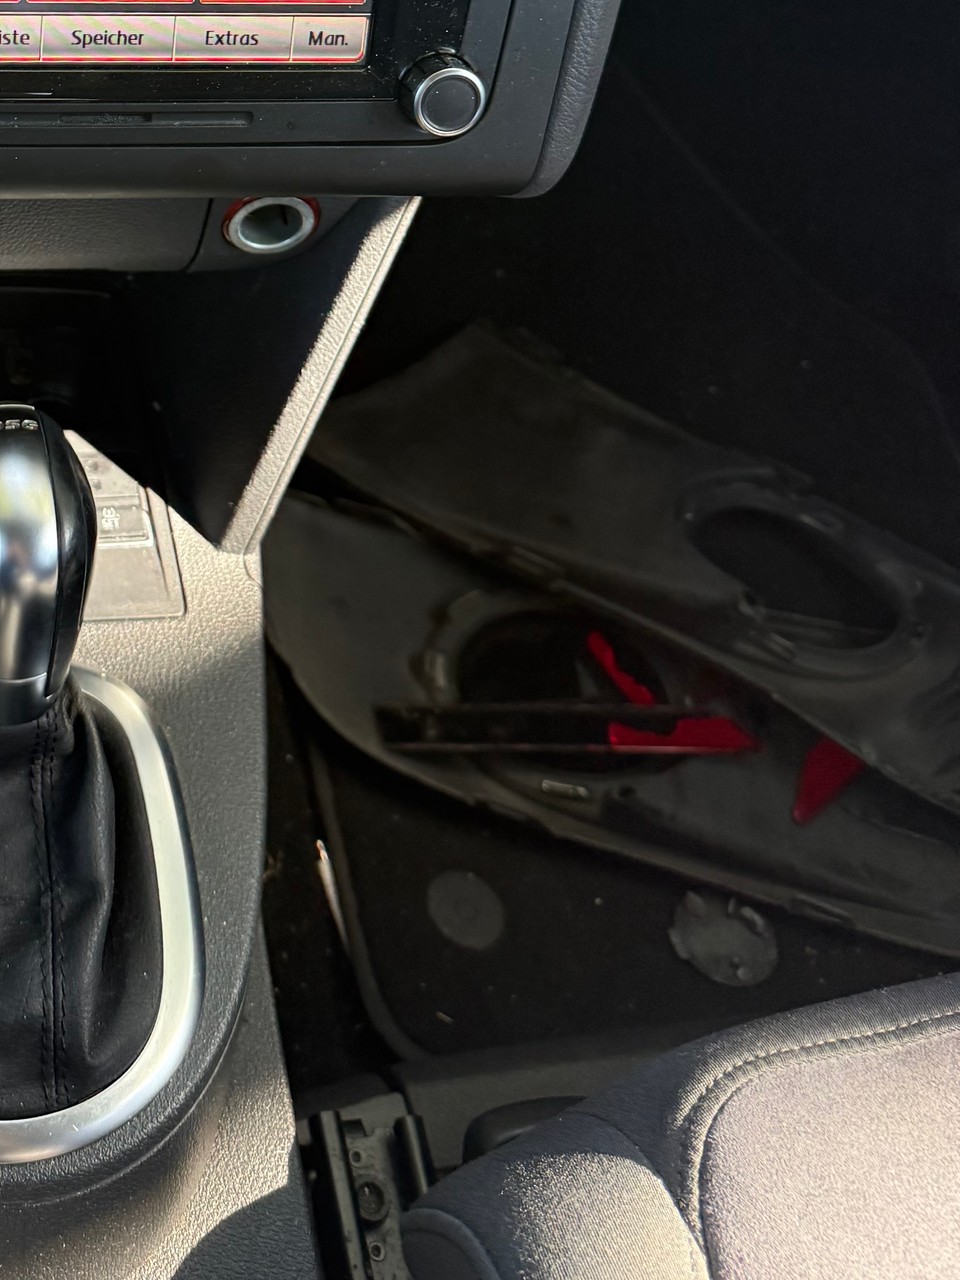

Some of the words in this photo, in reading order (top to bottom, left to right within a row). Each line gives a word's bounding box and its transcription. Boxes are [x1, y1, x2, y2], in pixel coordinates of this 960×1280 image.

[71, 29, 144, 49] Speicher
[205, 30, 259, 46] Extras
[308, 31, 348, 46] Man.
